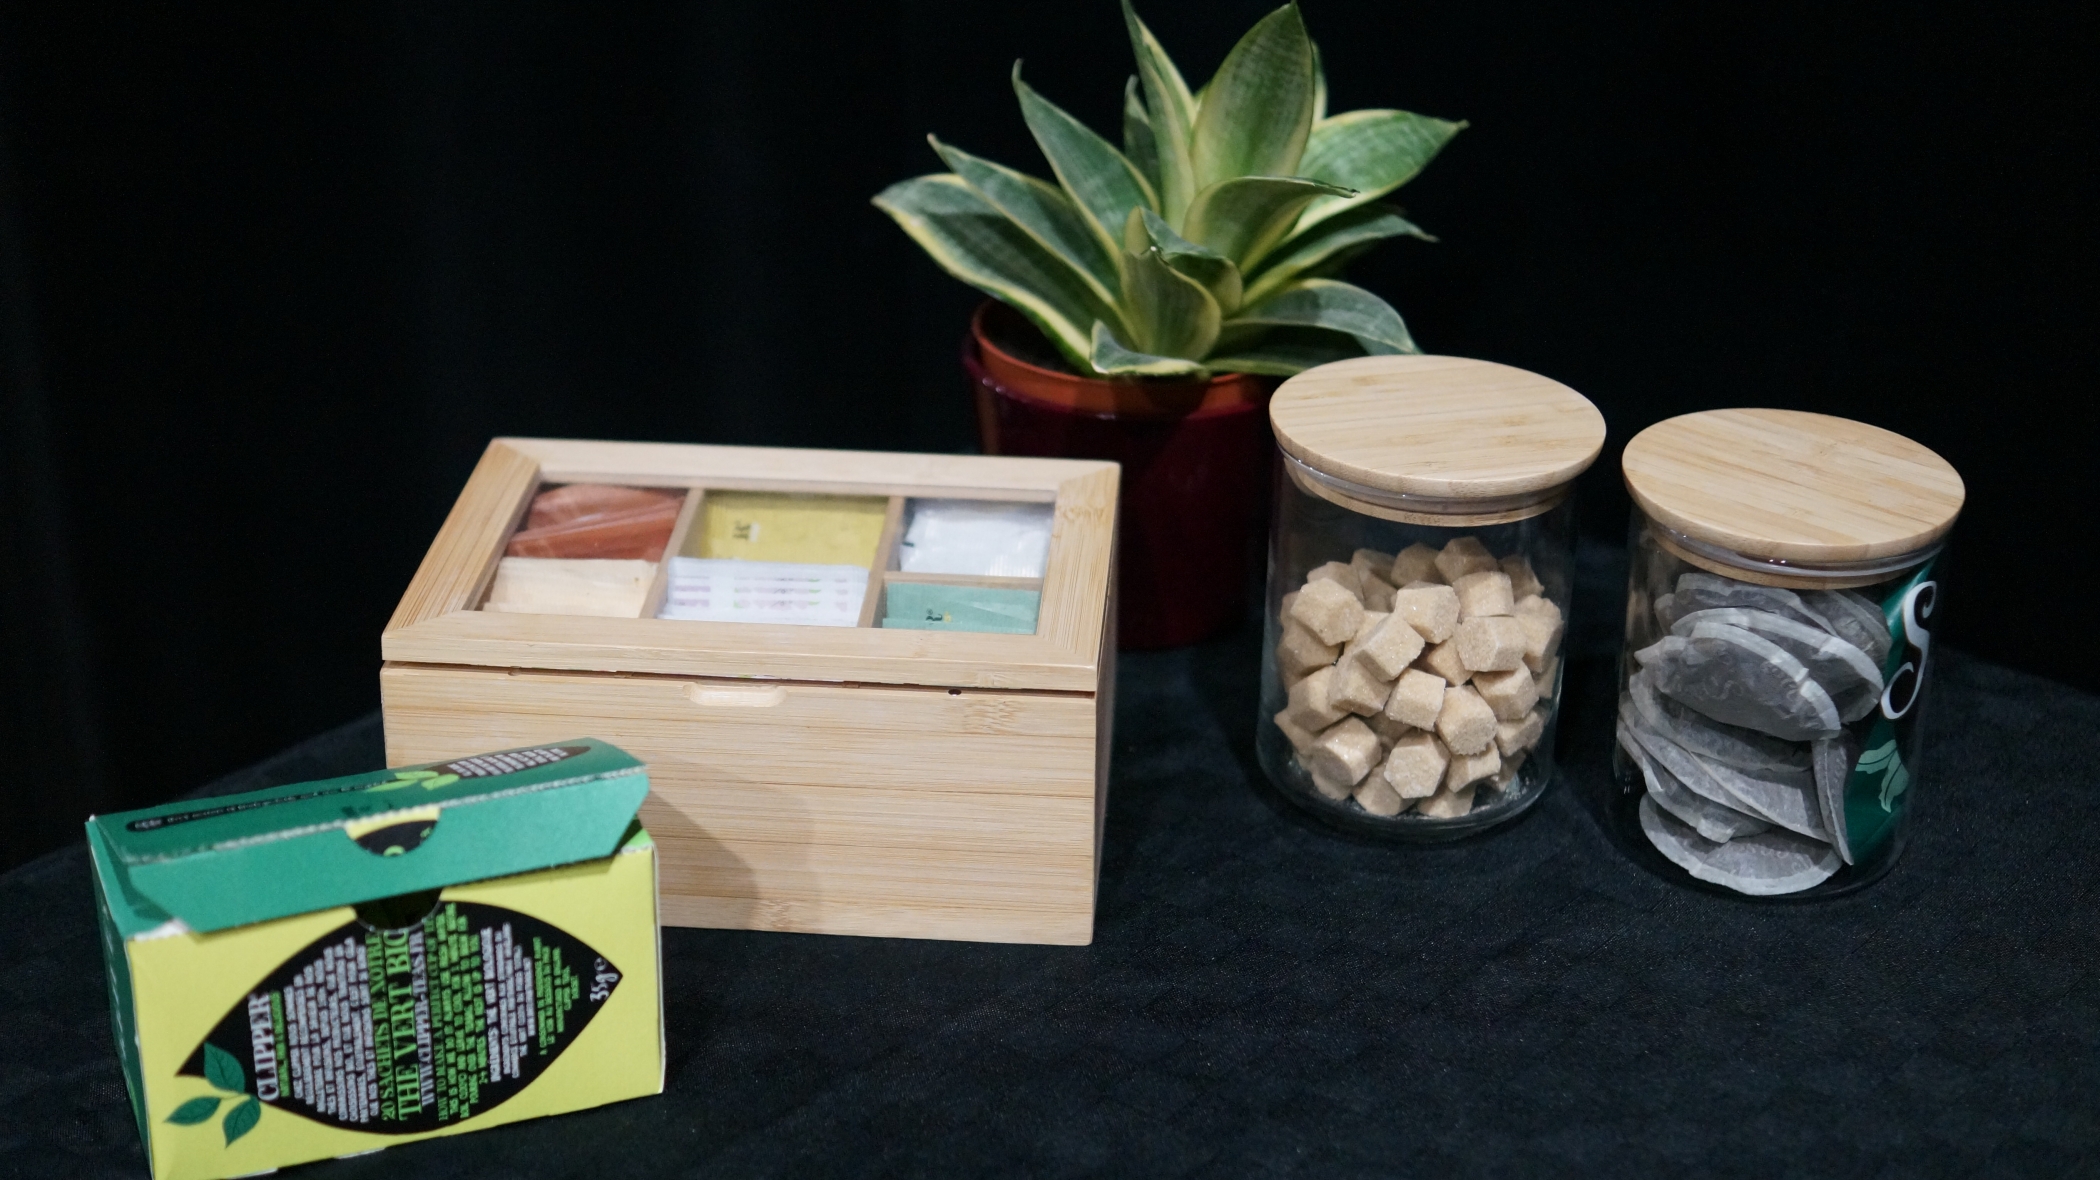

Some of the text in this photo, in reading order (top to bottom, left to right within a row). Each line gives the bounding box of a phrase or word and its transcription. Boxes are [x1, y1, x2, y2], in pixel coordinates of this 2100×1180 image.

[425, 937, 436, 952] OF
[427, 954, 438, 977] CUP
[589, 971, 621, 1002] 35g
[408, 931, 436, 1106] WWW.CLIPPER-TEAS.FR
[429, 978, 441, 1028] PERFECT
[365, 933, 396, 1121] 20 SACHETS DE NOTRE
[387, 981, 418, 1060] VERT
[433, 1031, 442, 1039] A
[248, 994, 280, 1102] CLIPPER
[434, 1042, 445, 1076] MAKE
[437, 1078, 446, 1092] TO
[438, 1097, 448, 1120] HOW
